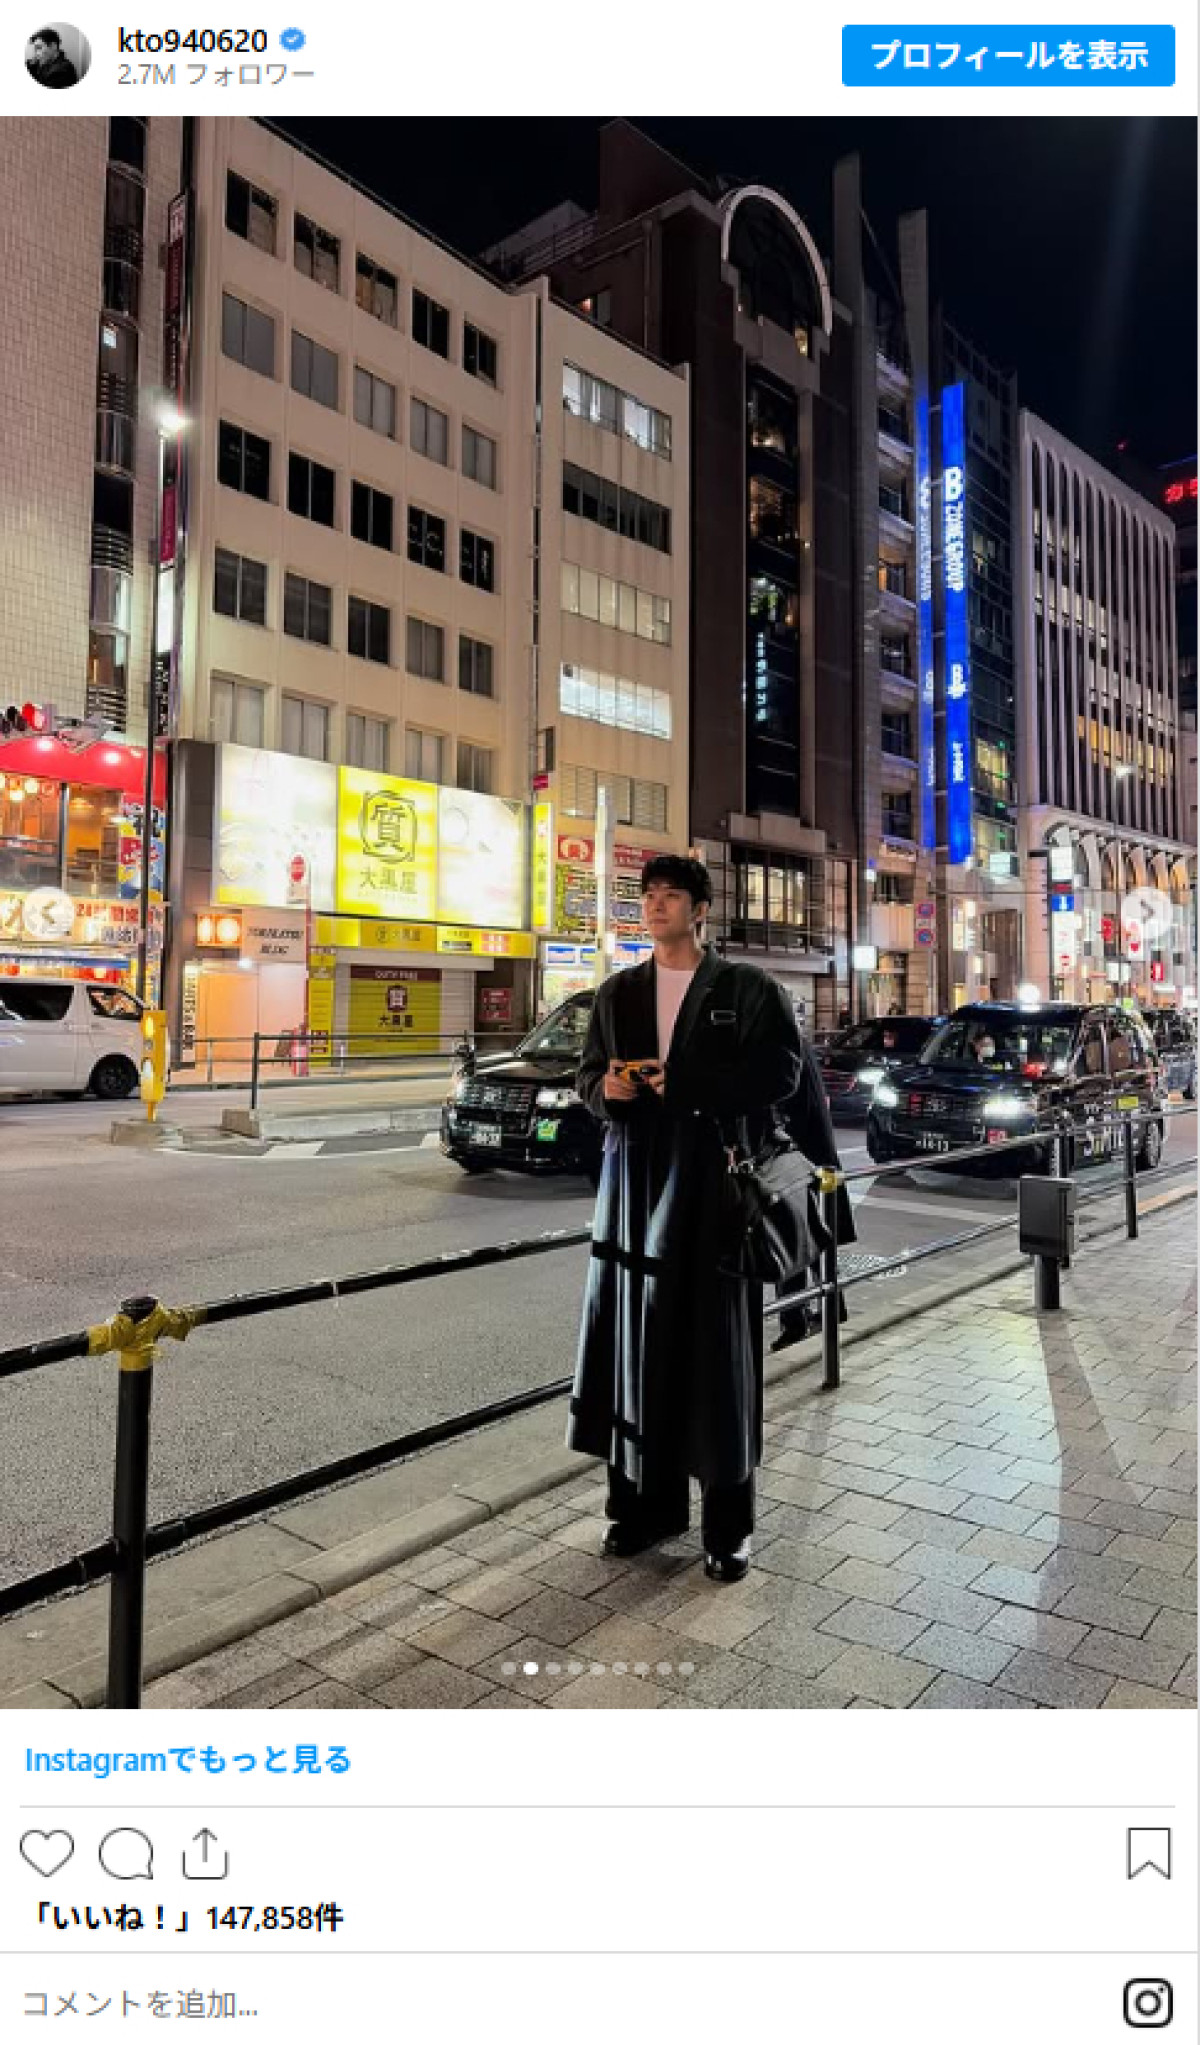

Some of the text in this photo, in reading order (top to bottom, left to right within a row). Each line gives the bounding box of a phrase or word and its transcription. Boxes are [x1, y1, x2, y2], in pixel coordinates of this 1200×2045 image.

[360, 866, 418, 896] 大黒屋
[379, 1013, 414, 1028] 大黒屋
